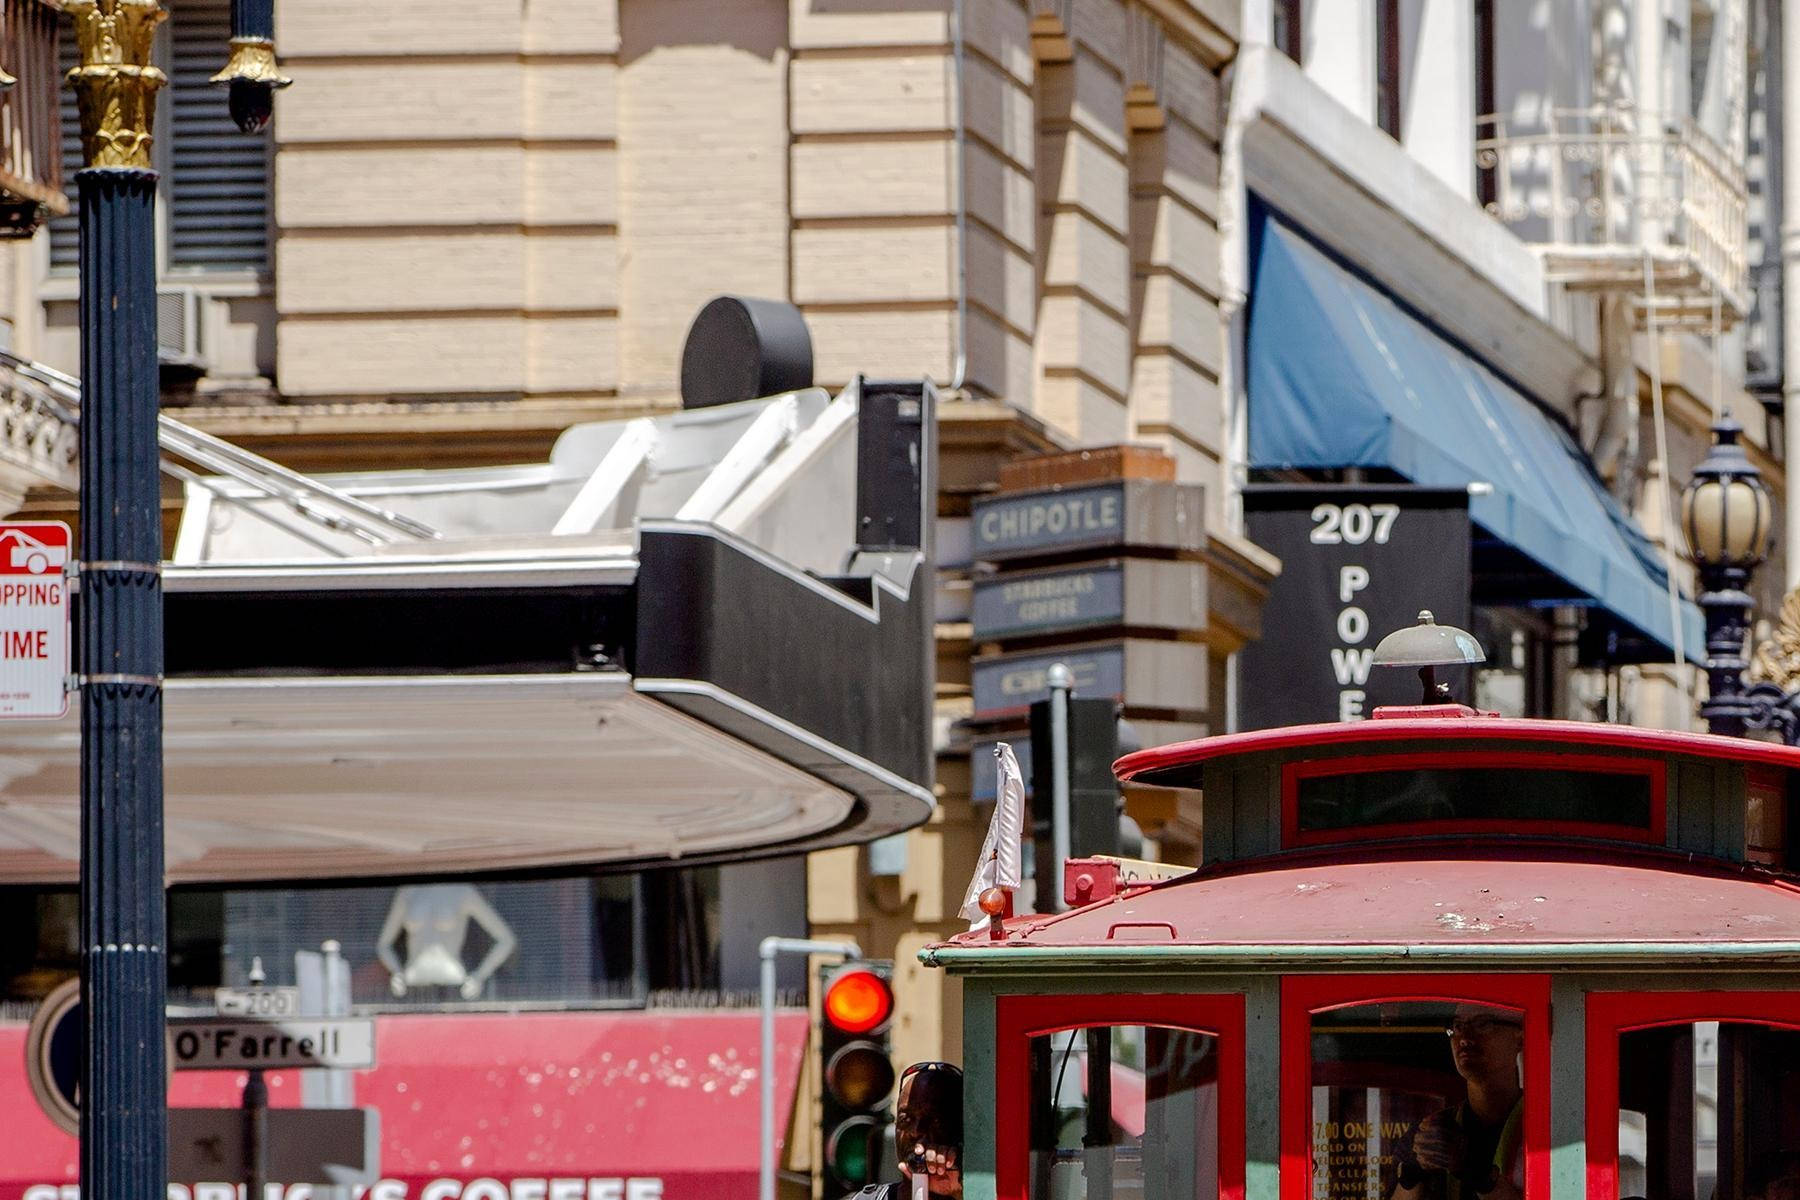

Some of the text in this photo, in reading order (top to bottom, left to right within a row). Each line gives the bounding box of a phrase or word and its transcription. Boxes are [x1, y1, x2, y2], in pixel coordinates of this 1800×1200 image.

[981, 496, 1117, 542] CHIPOTLE
[1310, 503, 1400, 544] 207
[0, 583, 60, 606] PPING
[0, 631, 48, 658] IME
[176, 1029, 340, 1060] O'Farrell
[1344, 1122, 1375, 1139] ONE
[1381, 1122, 1410, 1139] WAY
